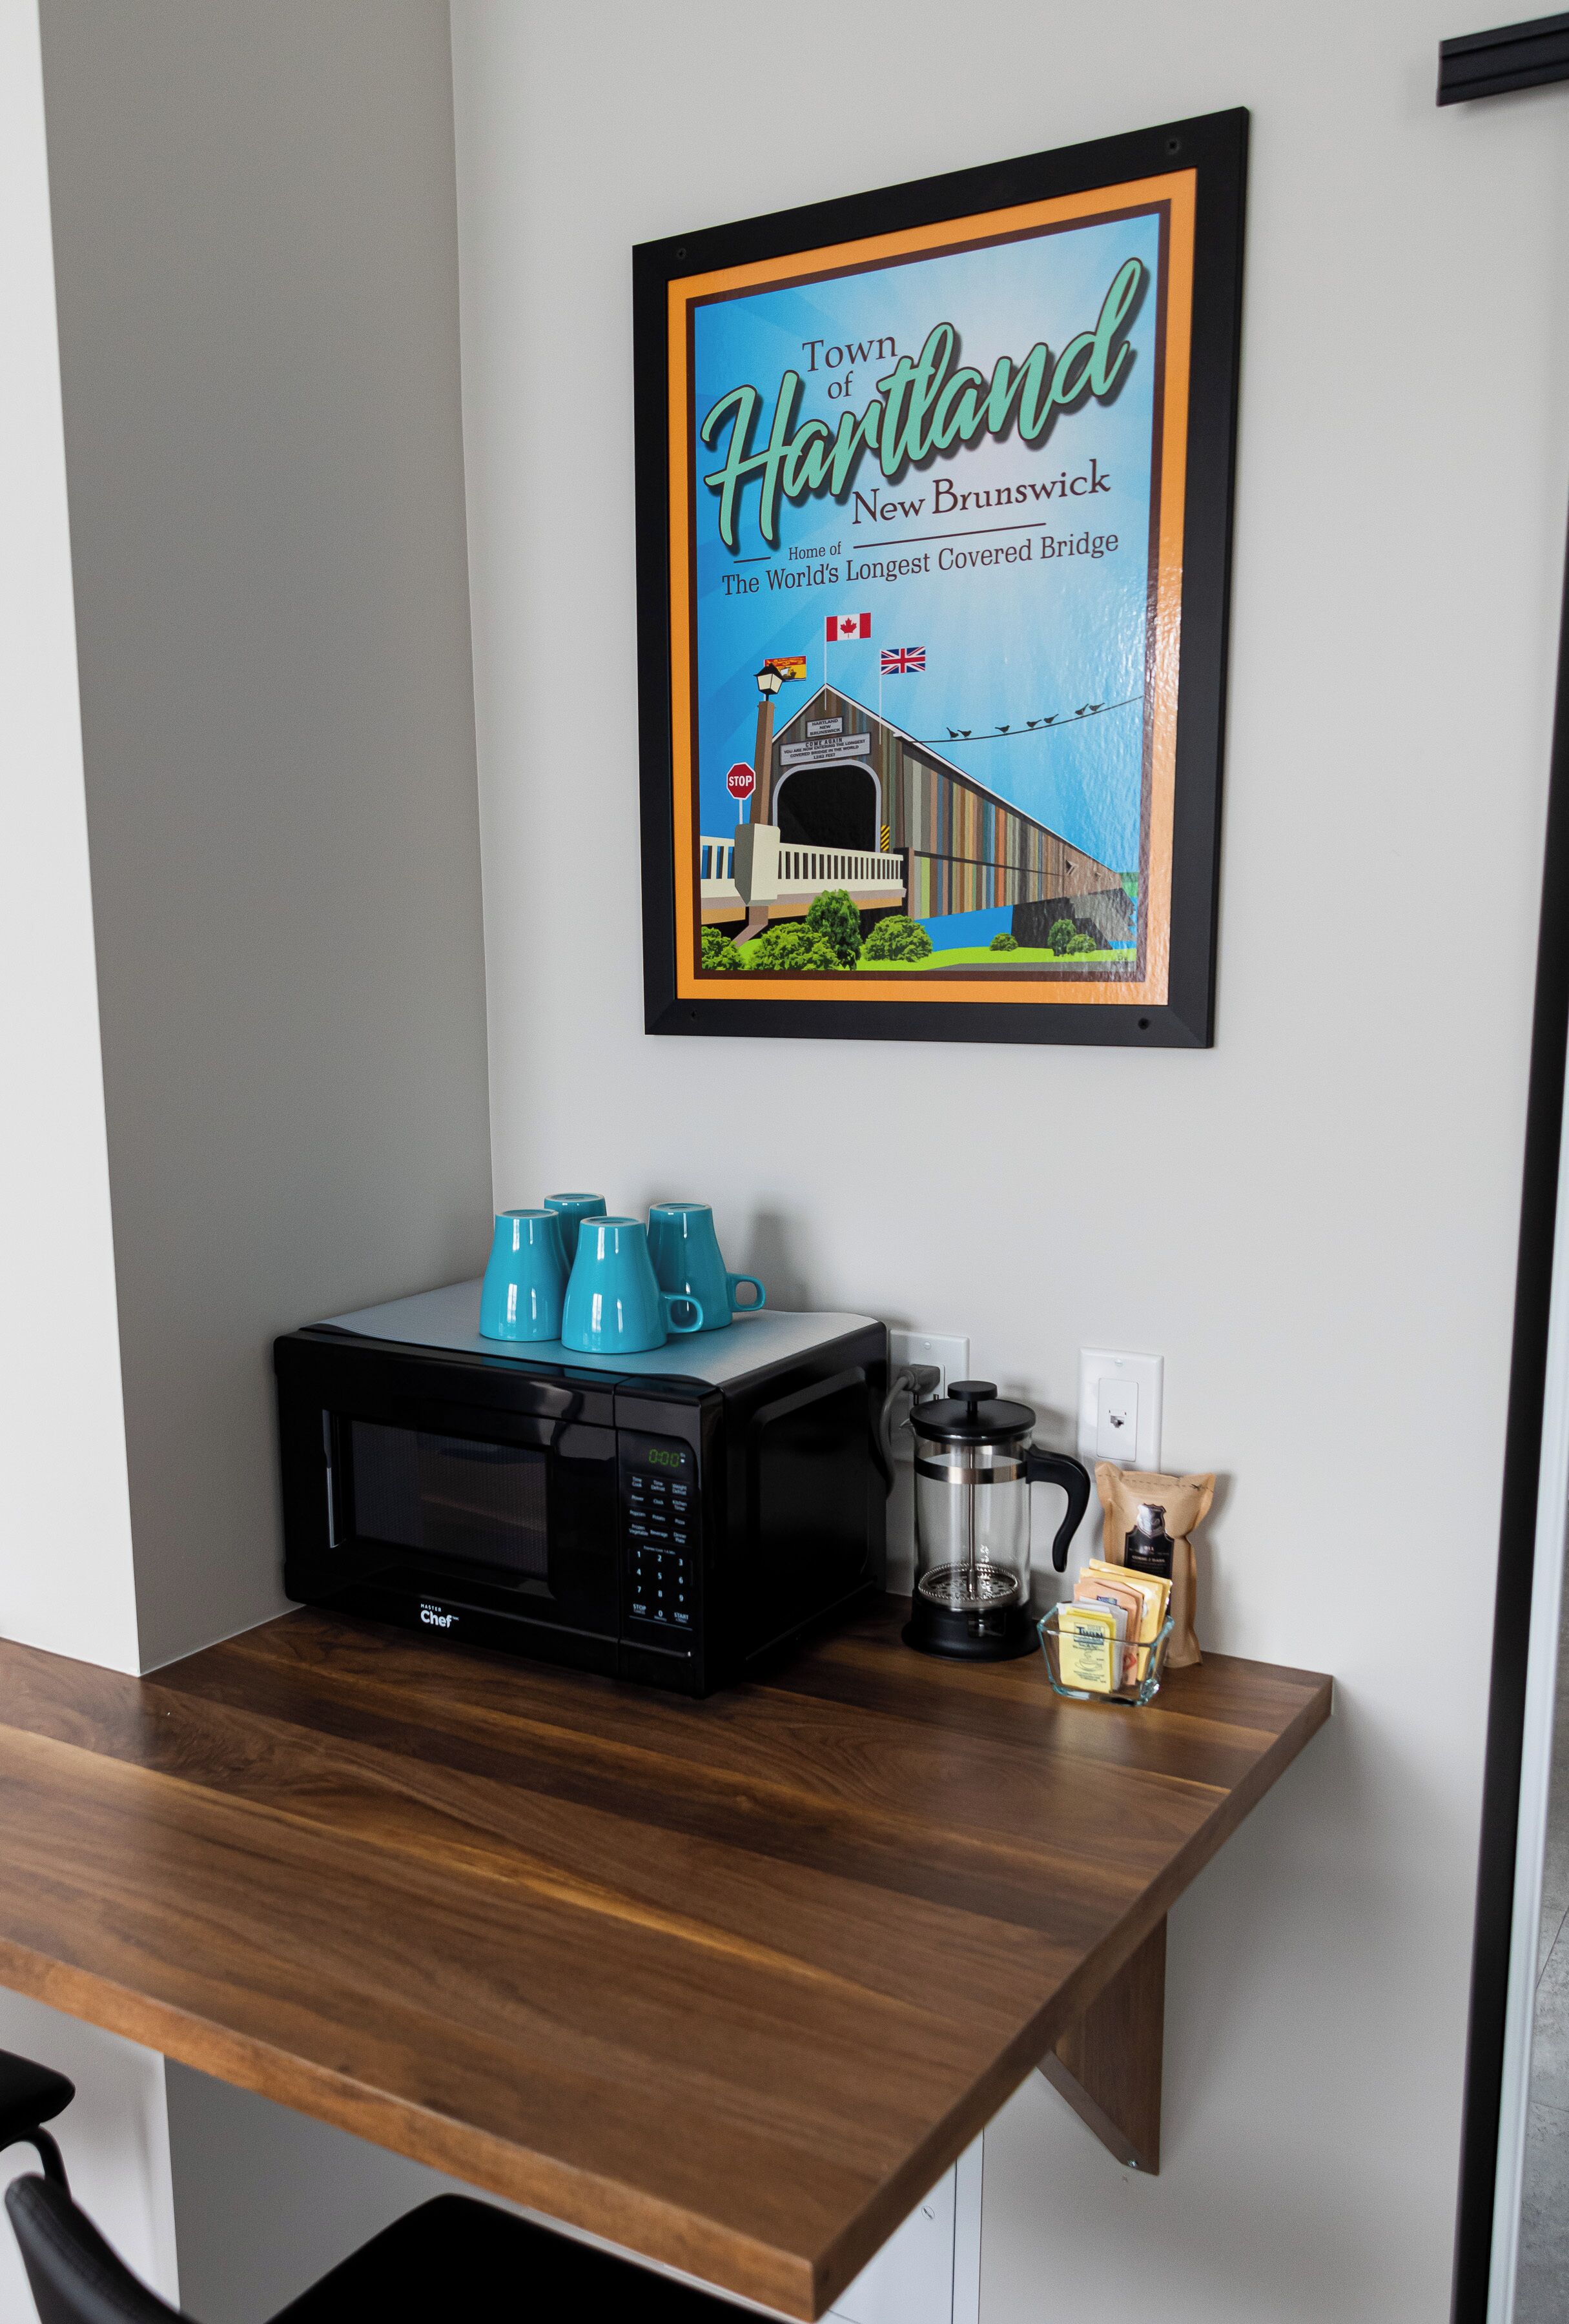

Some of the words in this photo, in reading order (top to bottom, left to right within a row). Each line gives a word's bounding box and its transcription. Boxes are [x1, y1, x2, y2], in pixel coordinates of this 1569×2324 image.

[802, 334, 898, 372] Town
[827, 371, 853, 401] of
[701, 257, 1143, 546] Hartland
[852, 488, 926, 525] New
[932, 459, 1111, 515] Brunswick
[788, 544, 825, 562] Home
[828, 542, 842, 557] of
[722, 573, 761, 596] The
[765, 563, 839, 591] World's
[845, 547, 931, 582] Longest
[938, 537, 1033, 572] Covered
[1039, 529, 1119, 560] Bridge
[728, 775, 752, 787] STOP
[679, 1576, 683, 1584] 6
[658, 1589, 662, 1598] 8
[420, 1603, 442, 1612] MASTER
[420, 1609, 452, 1628] Chef
